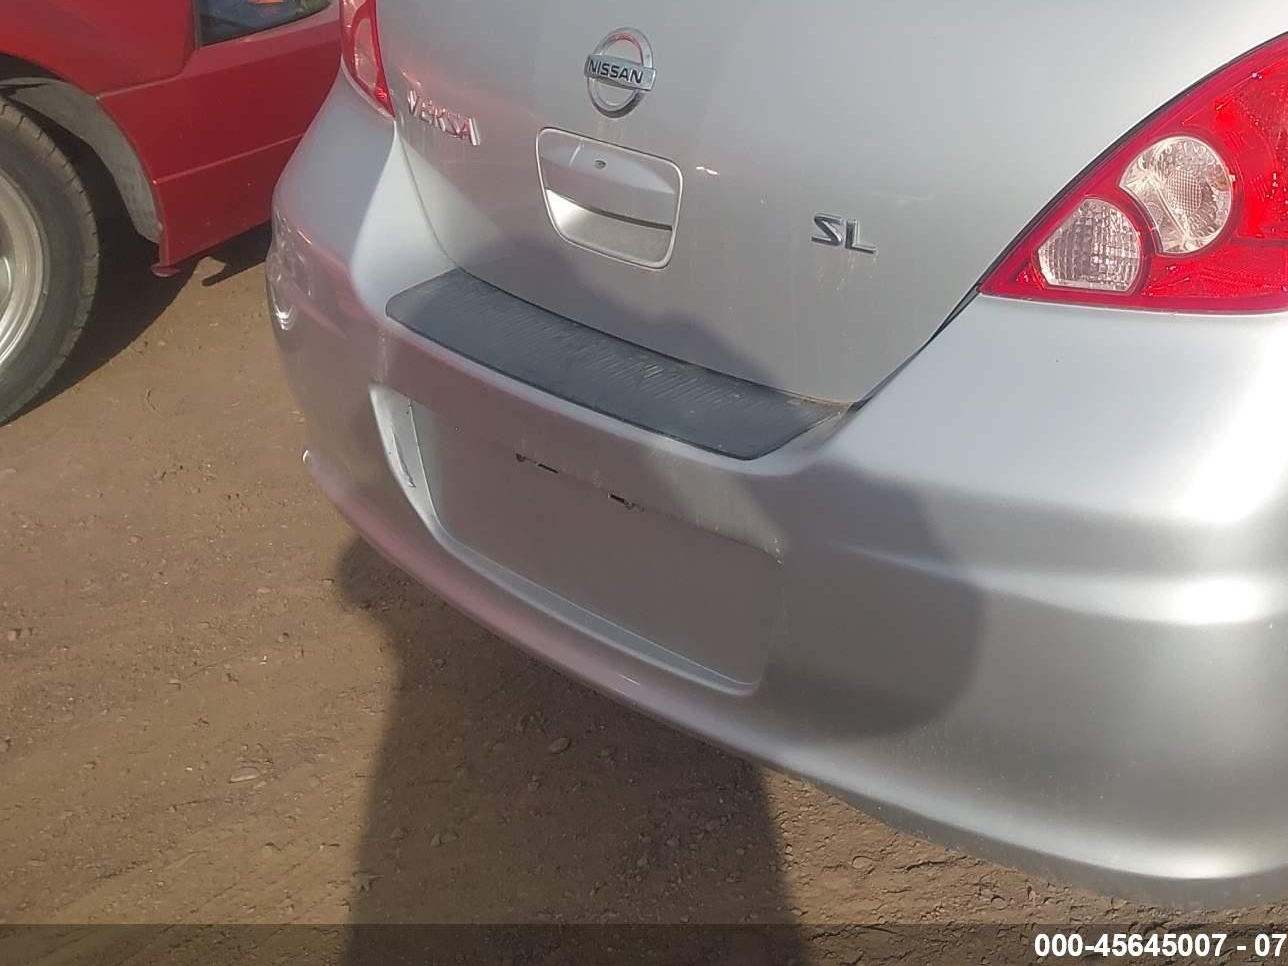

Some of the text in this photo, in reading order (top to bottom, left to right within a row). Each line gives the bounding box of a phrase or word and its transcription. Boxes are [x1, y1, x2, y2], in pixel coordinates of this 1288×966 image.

[589, 59, 644, 84] NISSAN
[407, 89, 481, 146] VERSA
[811, 213, 877, 255] SL
